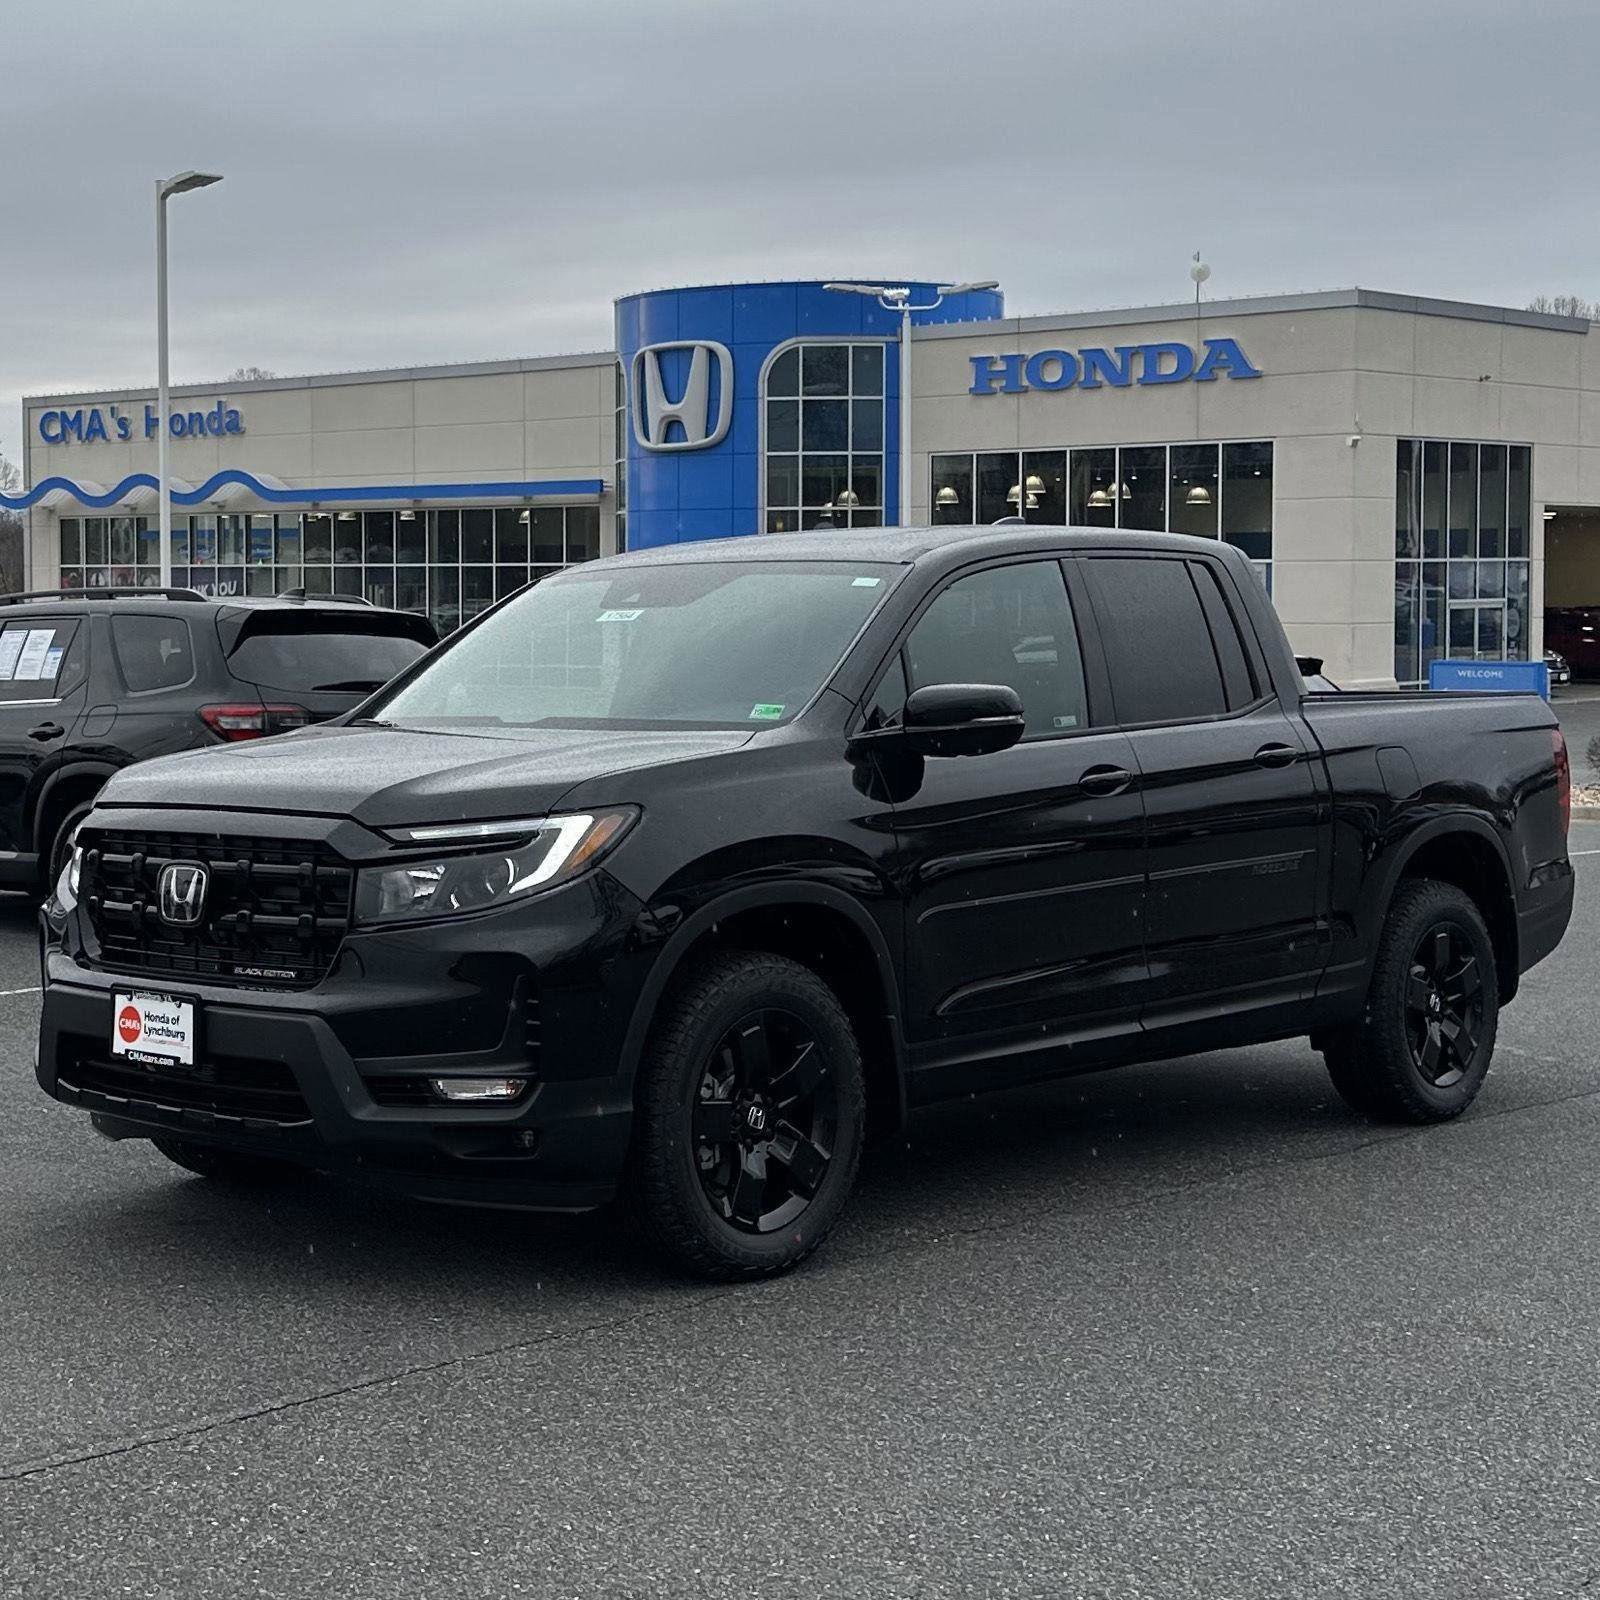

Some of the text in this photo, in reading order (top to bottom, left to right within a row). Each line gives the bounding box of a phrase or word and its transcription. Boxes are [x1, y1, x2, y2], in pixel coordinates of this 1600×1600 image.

[969, 338, 1263, 395] HONDA
[39, 406, 131, 443] CMA's
[211, 581, 237, 597] YOU
[1457, 669, 1504, 678] WELCOME
[234, 967, 297, 978] BLACK EDITION
[144, 1011, 180, 1026] Honda of
[144, 1024, 186, 1041] Lynchburg
[128, 1051, 174, 1066] CMAcars.com
